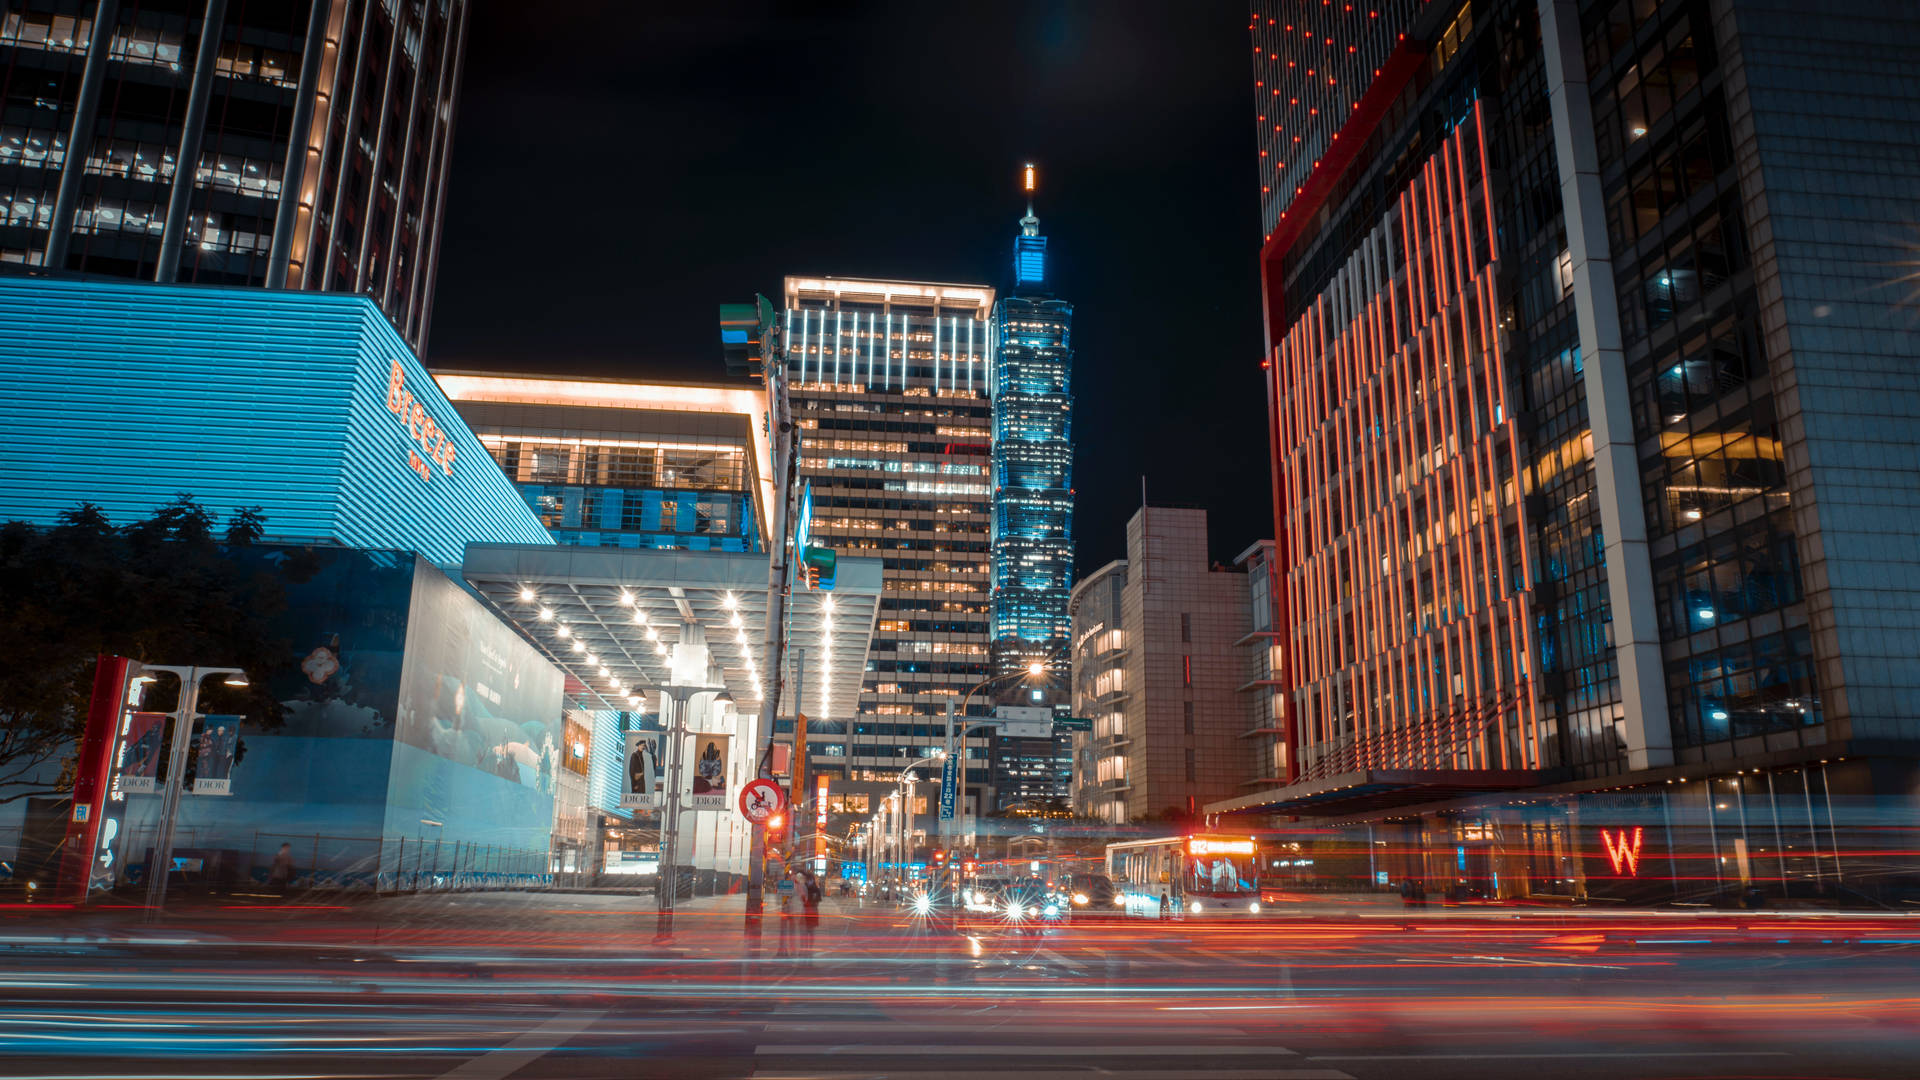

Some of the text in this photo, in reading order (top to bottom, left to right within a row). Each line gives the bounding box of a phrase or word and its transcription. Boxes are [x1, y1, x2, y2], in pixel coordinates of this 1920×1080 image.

[387, 359, 455, 476] Breeze
[122, 777, 150, 787] DIOR
[199, 780, 225, 790] DIOR
[624, 795, 650, 804] DIOR
[696, 796, 721, 805] DIOR
[102, 818, 118, 849] P
[1601, 828, 1642, 877] W
